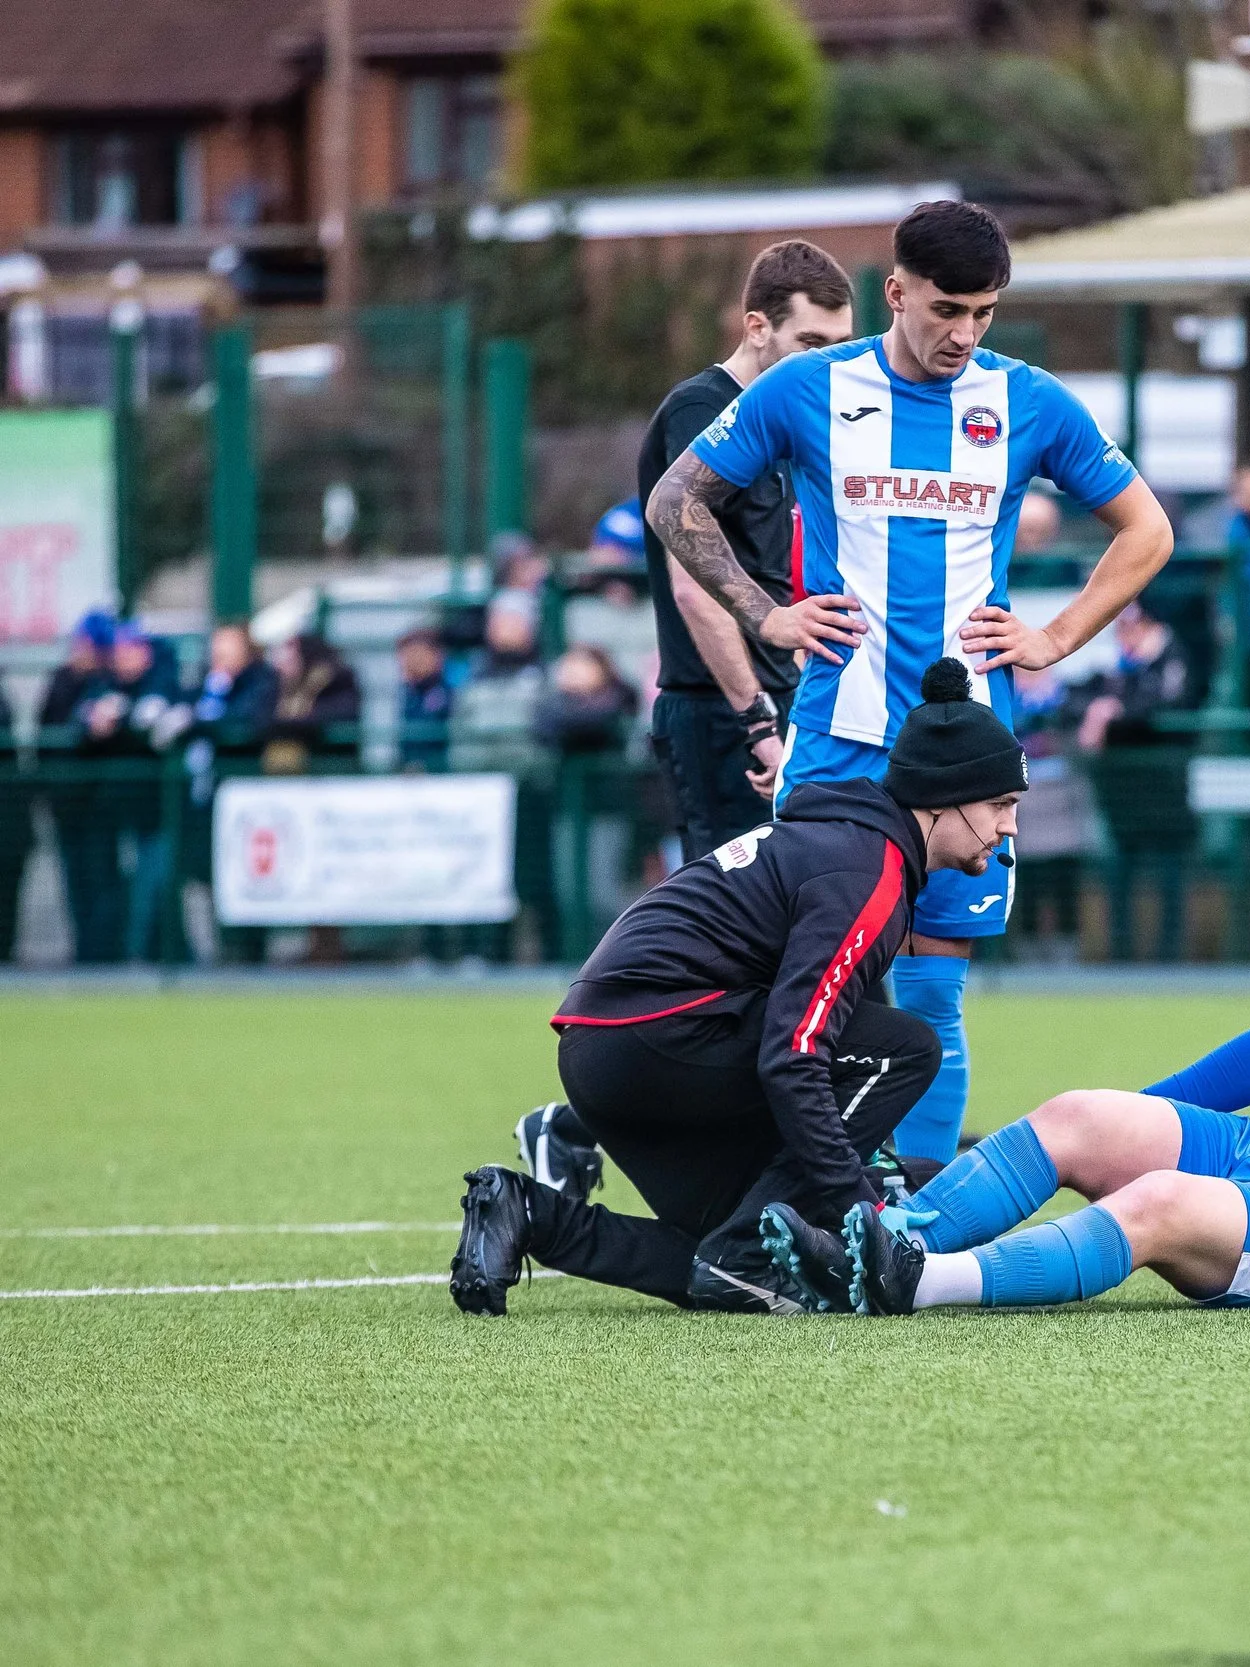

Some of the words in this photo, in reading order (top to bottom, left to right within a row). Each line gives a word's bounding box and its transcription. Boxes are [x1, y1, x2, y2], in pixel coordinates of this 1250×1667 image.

[844, 476, 996, 508] STUART
[850, 499, 895, 508] PLUMBING
[906, 502, 944, 511] HEATING
[946, 504, 986, 516] SUPPLIES
